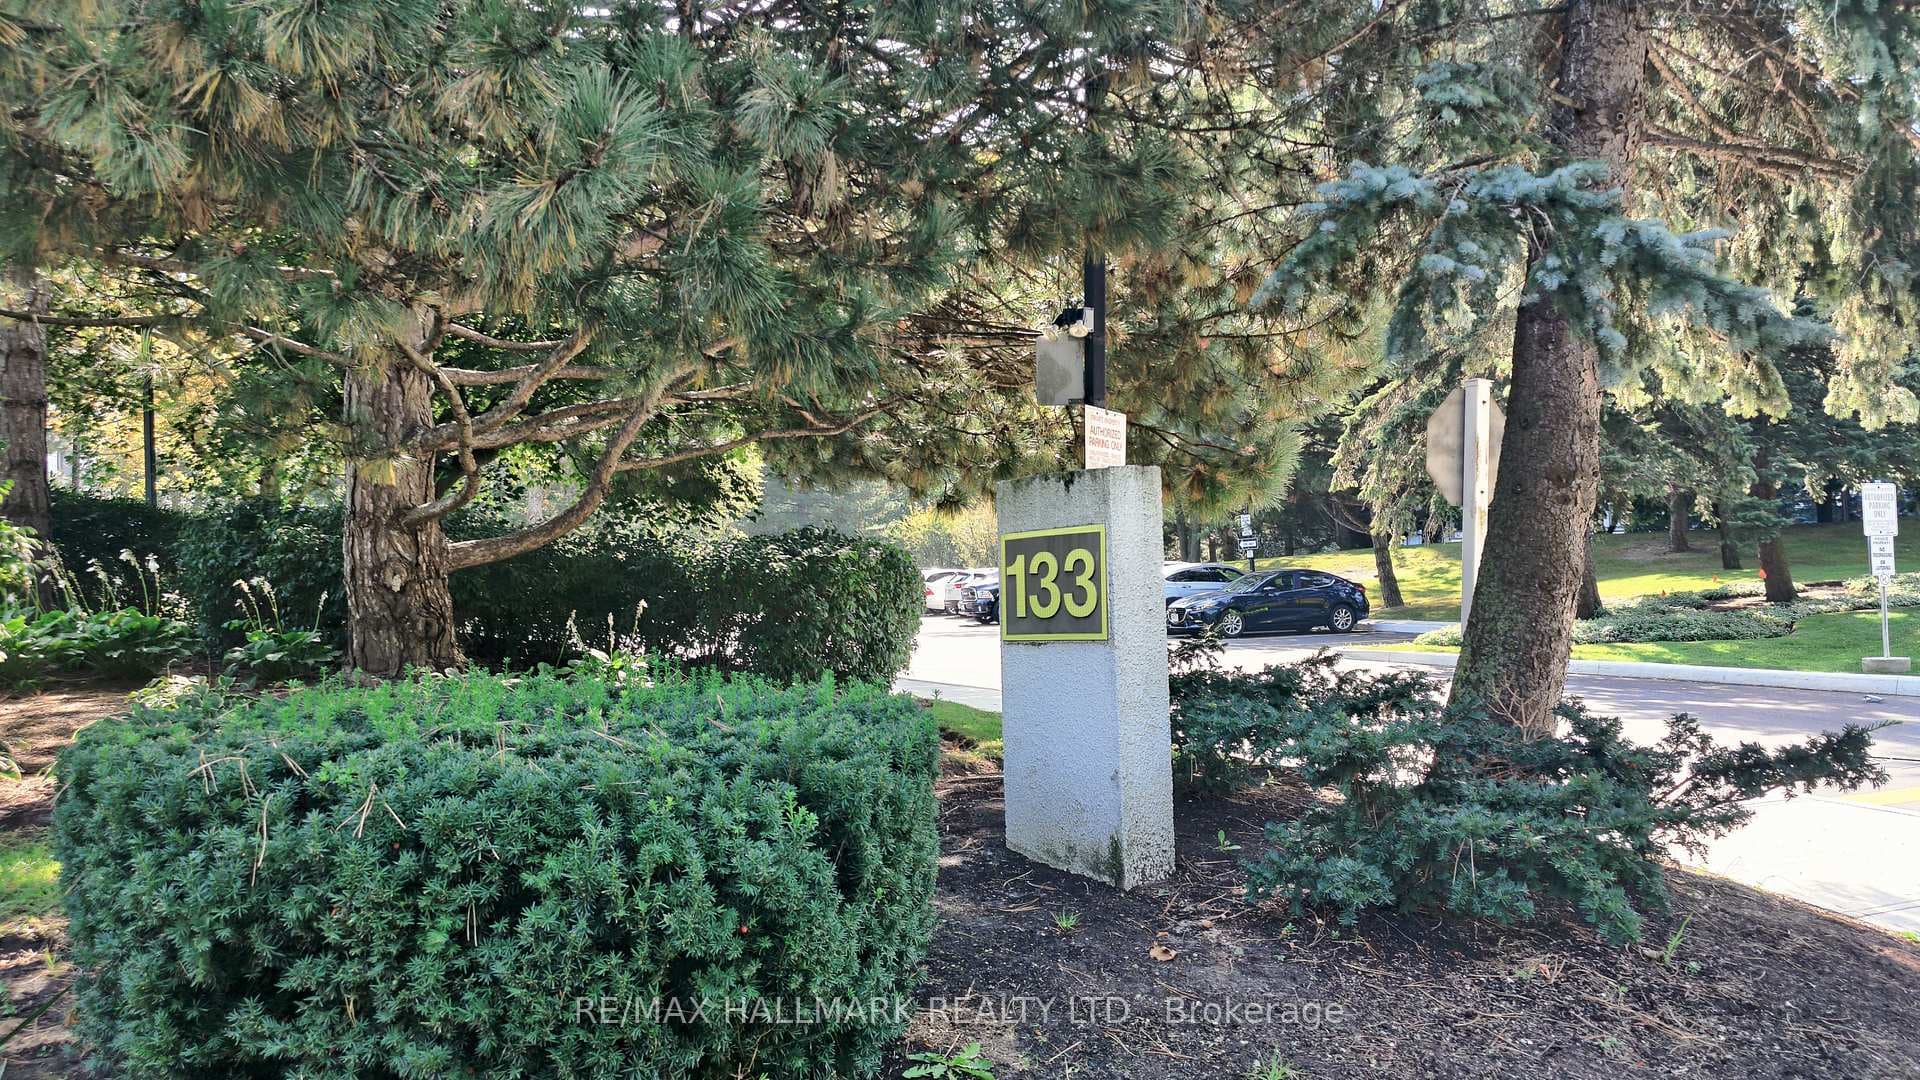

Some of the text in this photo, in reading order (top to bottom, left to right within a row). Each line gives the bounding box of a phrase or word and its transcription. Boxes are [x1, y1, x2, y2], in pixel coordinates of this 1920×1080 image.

[1090, 425, 1121, 440] AUTHORIZED
[1088, 436, 1110, 449] PARKING
[1868, 501, 1891, 509] PARKING
[1873, 510, 1886, 518] ONLY
[1006, 548, 1098, 619] 133
